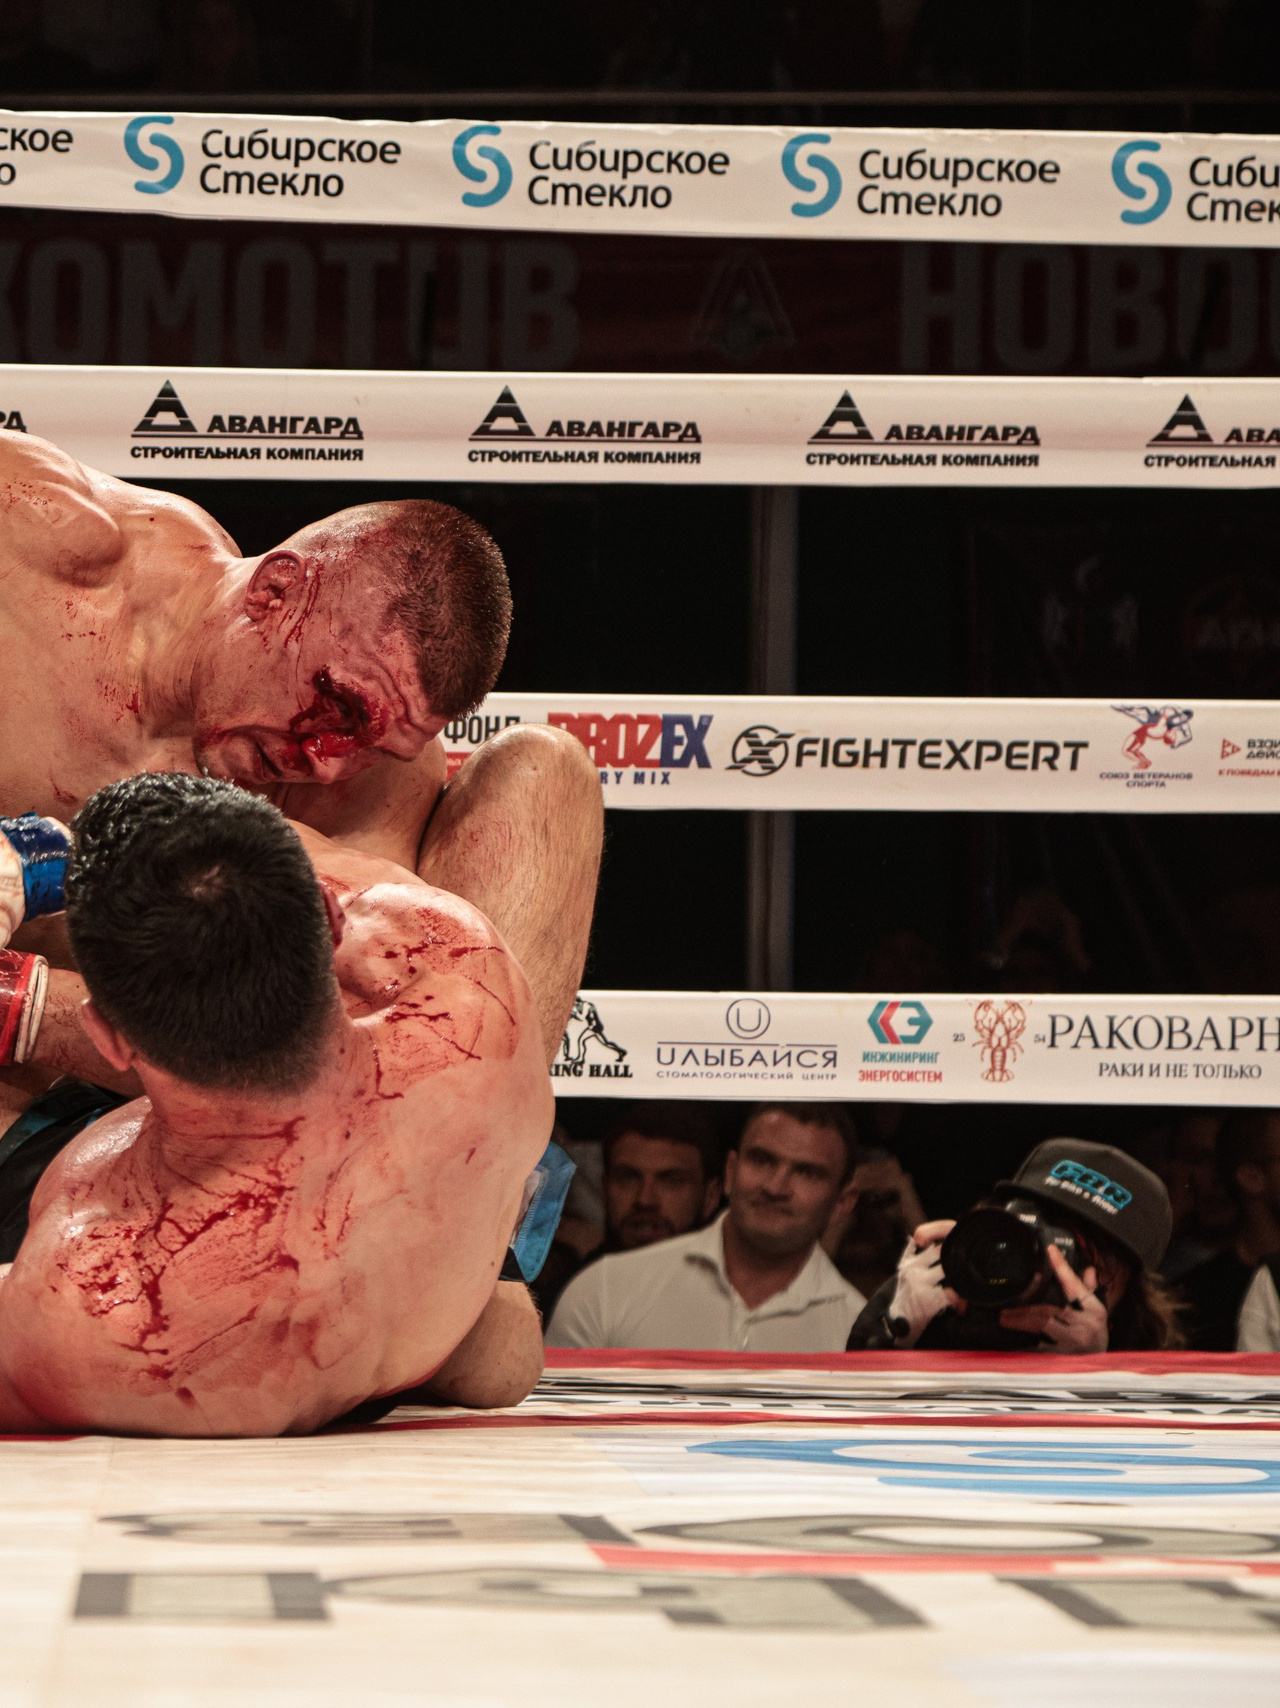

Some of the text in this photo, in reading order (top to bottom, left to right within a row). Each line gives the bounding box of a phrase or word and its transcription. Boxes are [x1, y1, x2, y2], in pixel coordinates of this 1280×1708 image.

[202, 129, 401, 166] Сибирское
[529, 140, 729, 178] Сибирское
[859, 149, 1060, 185] Сибирское
[200, 165, 344, 197] Стекло
[527, 176, 672, 208] Стекло
[857, 185, 1003, 217] Стекло
[899, 242, 1280, 372] НОВО
[207, 415, 364, 439] АВАНГАРД
[545, 420, 702, 443] АВАНГАРД
[884, 424, 1041, 445] АВАНГАРД
[131, 446, 364, 461] СТРОИТЕЛЬНАЯ КОМПАНИЯ
[468, 450, 701, 464] СТРОИТЕЛЬНАЯ КОМПАНИЯ
[806, 452, 1040, 467] СТРОИТЕЛЬНАЯ КОМПАНИЯ
[1144, 454, 1276, 468] СТРОИТЕЛЬНАЯ
[795, 737, 1089, 771] FIGHTEXPERT
[600, 771, 671, 785] RY MIX
[1126, 780, 1166, 788] СПОРТА
[1134, 772, 1193, 780] ВЕТЕРАНОВ
[953, 1033, 965, 1042] 25
[862, 1051, 940, 1064] ИНЖИНИРИНГ
[589, 1065, 633, 1078] HALL
[657, 1071, 793, 1080] СТОМАТОЛОГИЧЕСКИЙ
[859, 1070, 942, 1083] ЭНЕРГОСИСТЕМ
[1098, 1062, 1262, 1079] РАКИ И НЕ ТОЛЬКО
